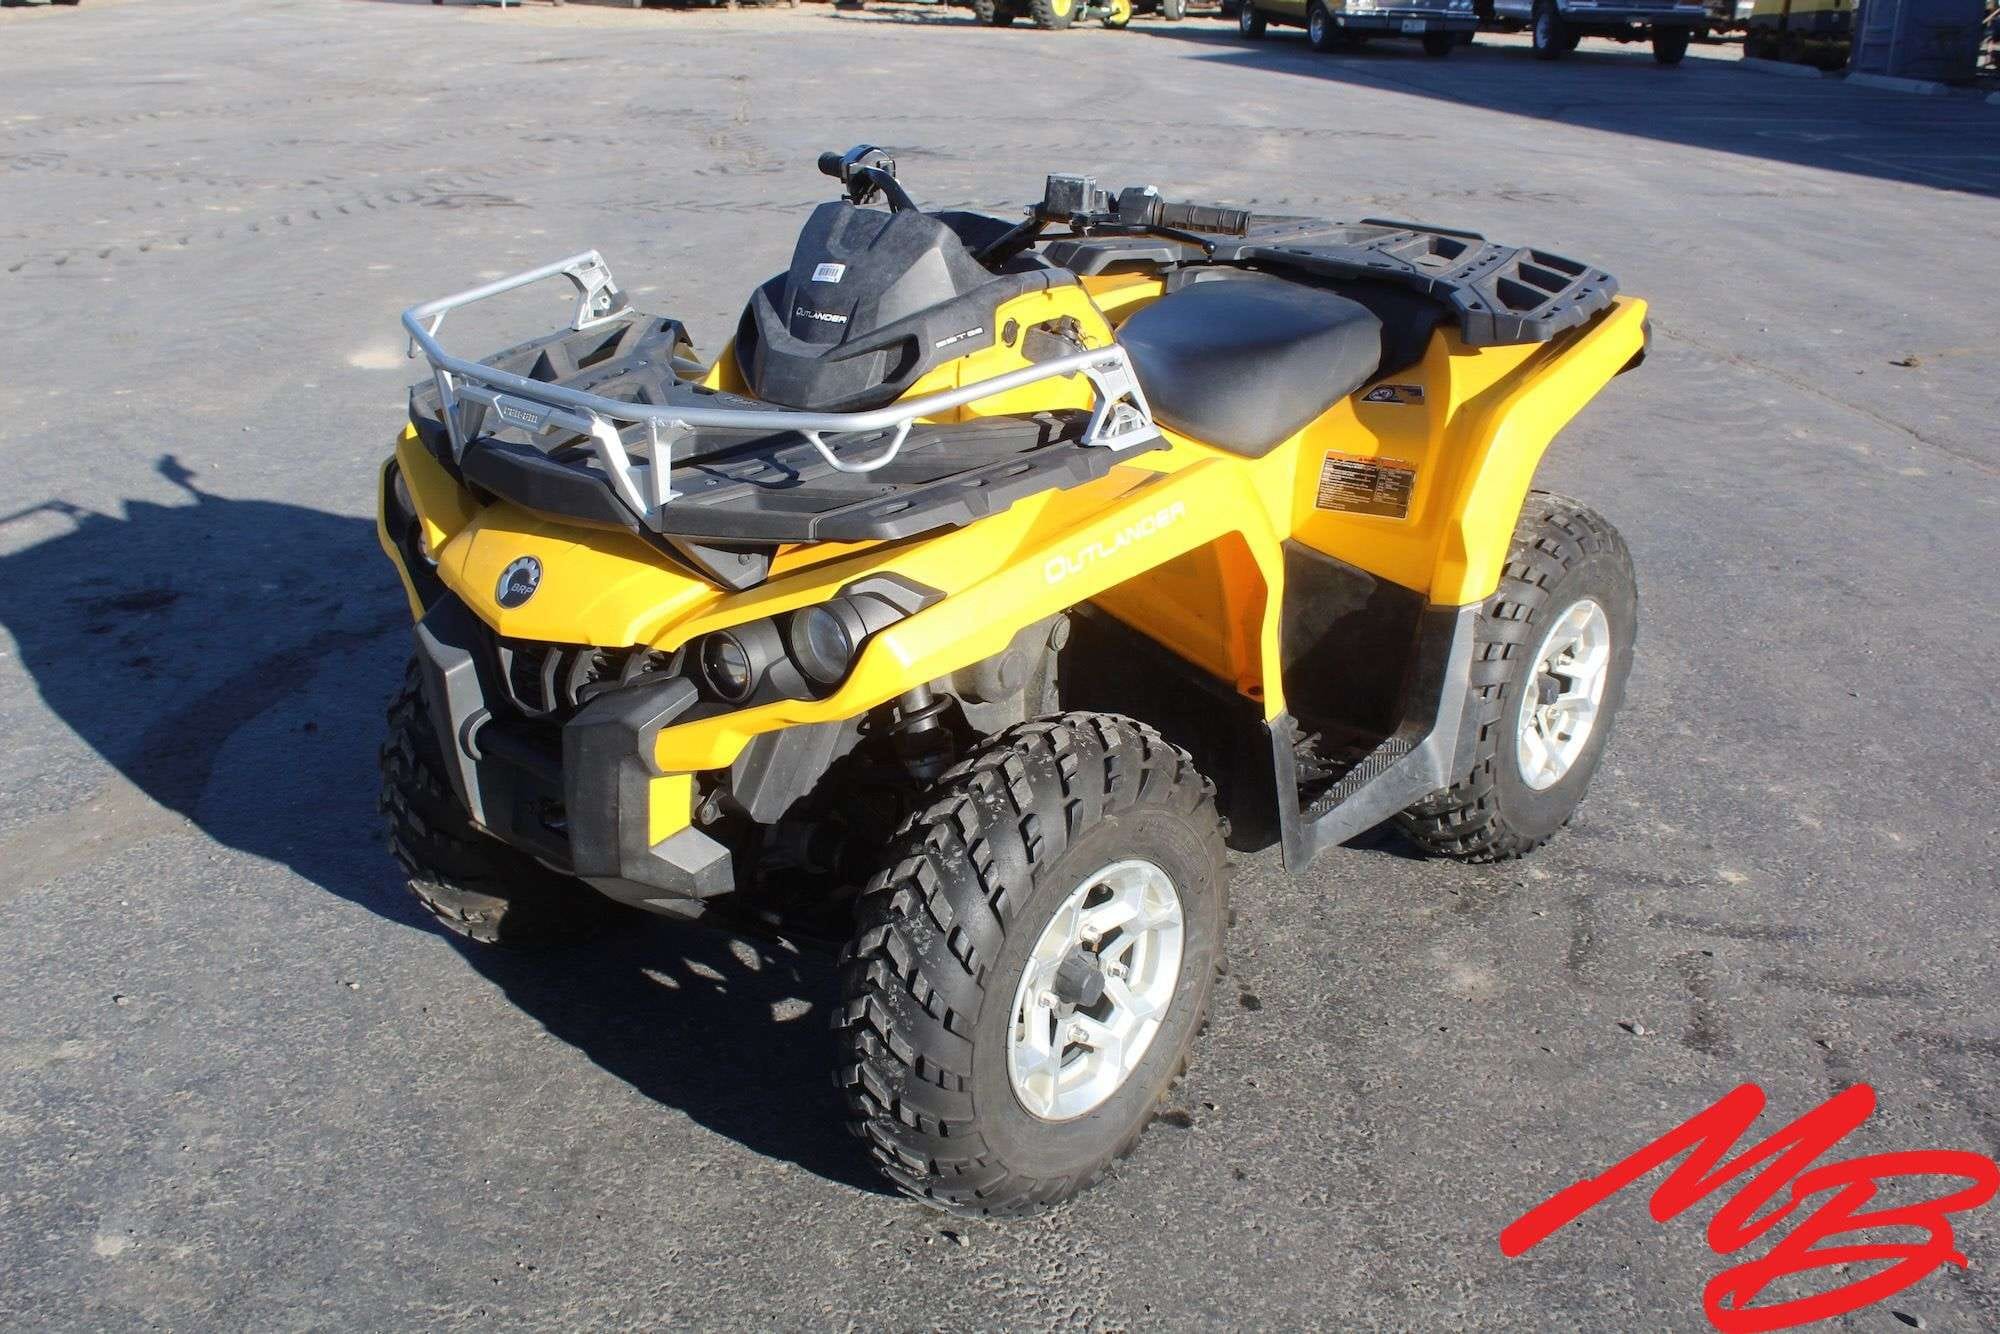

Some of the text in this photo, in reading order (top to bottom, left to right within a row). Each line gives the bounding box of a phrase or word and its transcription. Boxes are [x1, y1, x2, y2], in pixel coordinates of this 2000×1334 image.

[796, 307, 847, 323] OUTLANDER
[1045, 501, 1184, 583] OUTLANDER
[511, 583, 534, 594] BRP
